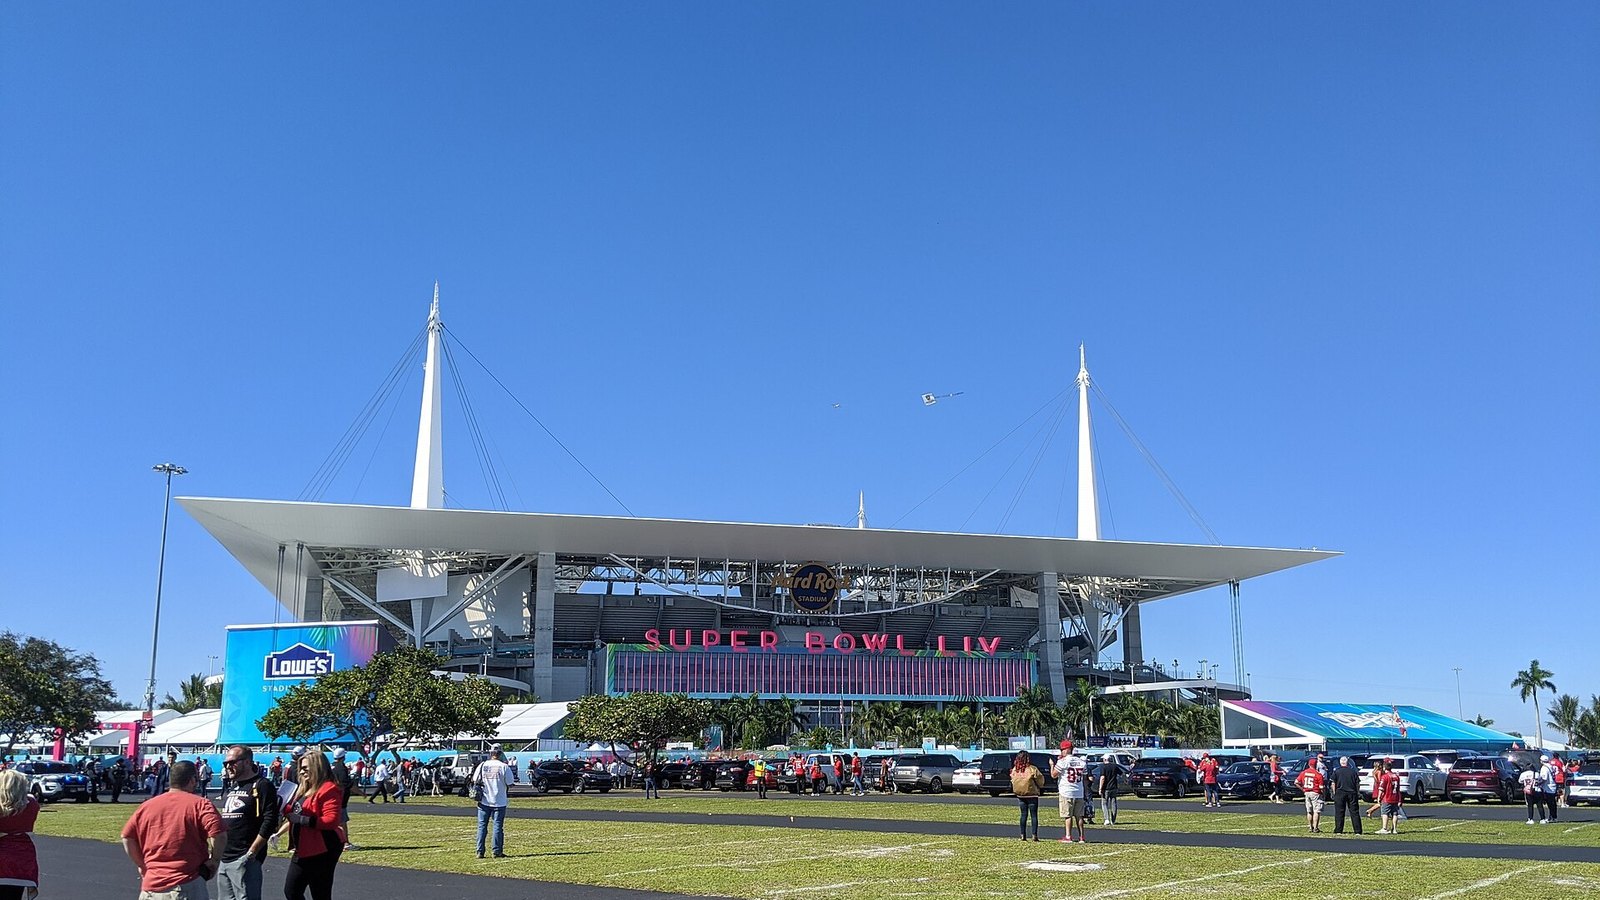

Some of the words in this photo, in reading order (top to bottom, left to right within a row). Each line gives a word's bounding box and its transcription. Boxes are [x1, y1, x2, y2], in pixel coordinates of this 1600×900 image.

[771, 572, 814, 589] Hard
[815, 573, 851, 593] Rock
[645, 629, 778, 653] SUPER
[805, 632, 915, 656] BOWL
[938, 635, 1001, 657] LIV
[271, 657, 329, 675] LOWE'S
[1303, 777, 1314, 788] 15
